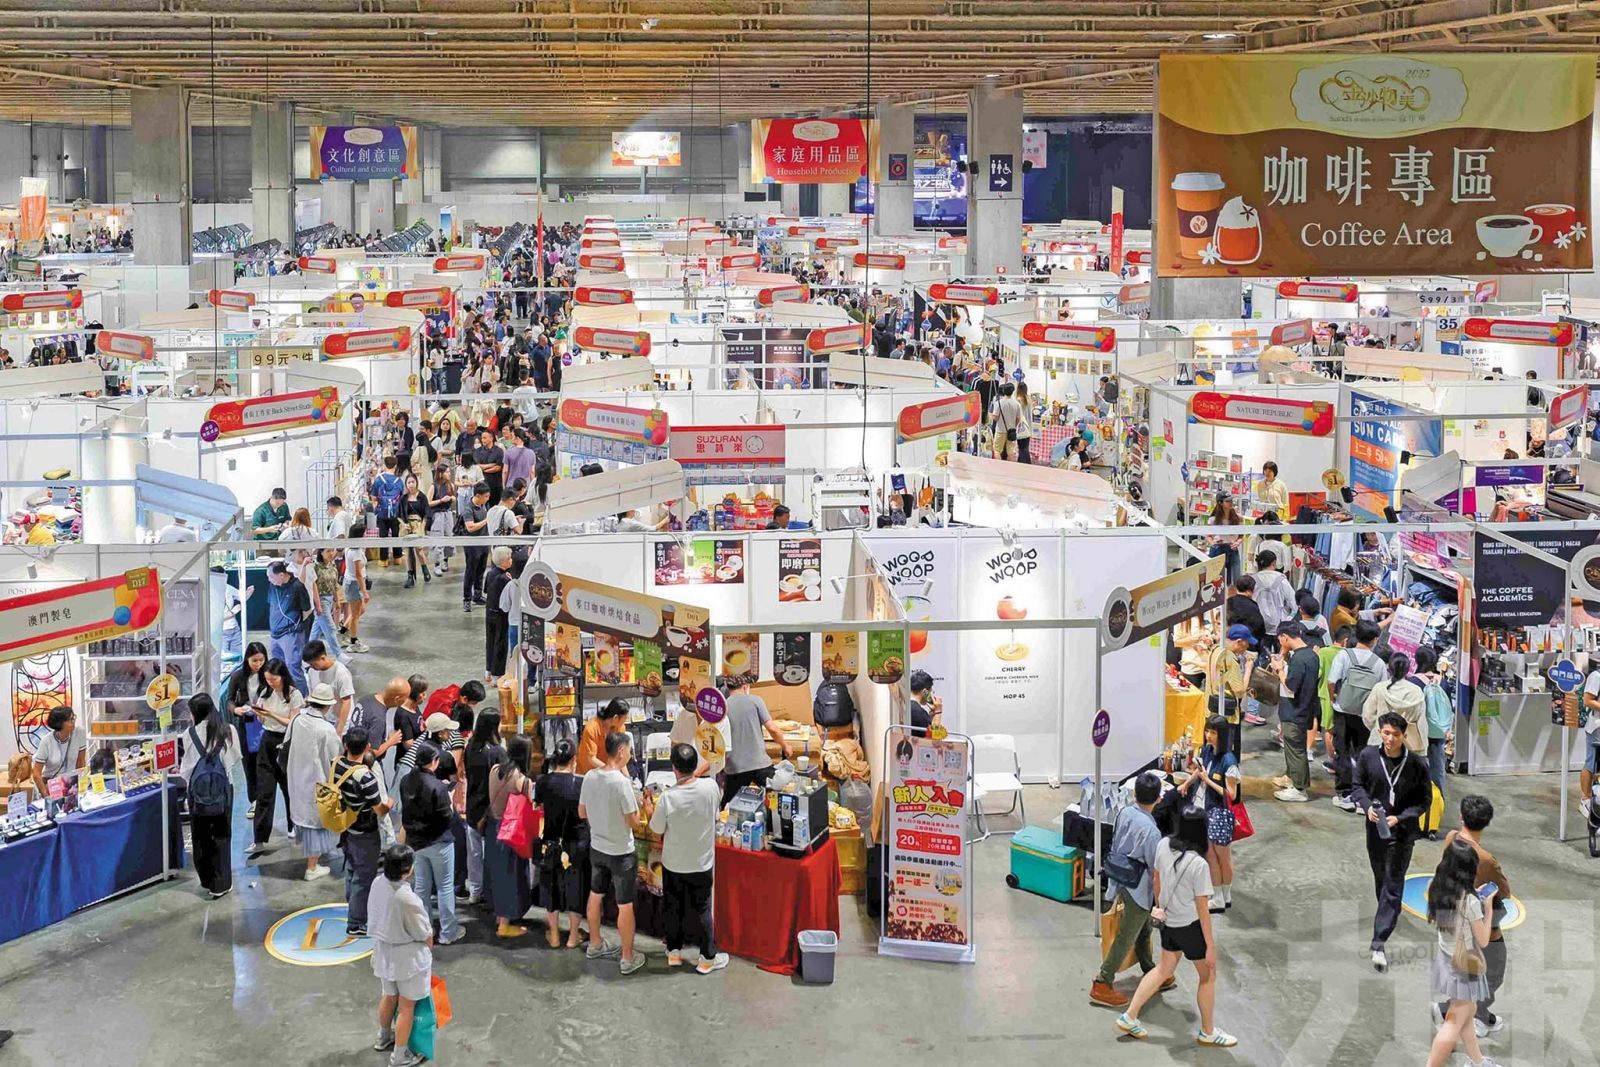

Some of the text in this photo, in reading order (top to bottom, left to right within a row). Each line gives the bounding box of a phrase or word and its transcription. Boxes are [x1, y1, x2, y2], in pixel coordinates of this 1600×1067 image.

[327, 148, 401, 163] 文化創意區
[772, 145, 860, 163] 家庭用品區
[357, 165, 369, 174] and
[777, 166, 818, 177] Household
[1263, 145, 1497, 207] 咖啡專區
[1301, 222, 1454, 247] Coffee Area
[1439, 318, 1457, 330] 35
[1236, 406, 1294, 418] NATURE REPUBLIC
[696, 435, 743, 443] SUZURAN
[1354, 421, 1374, 439] SUN
[882, 550, 935, 573] WOOP
[887, 563, 935, 586] WOOP
[989, 561, 1037, 584] WOOP
[132, 578, 147, 588] D17
[1498, 586, 1534, 594] COFFEE
[28, 608, 72, 627] 澳門製皂
[154, 684, 171, 702] $1
[702, 735, 717, 754] $1
[157, 748, 174, 760] $100
